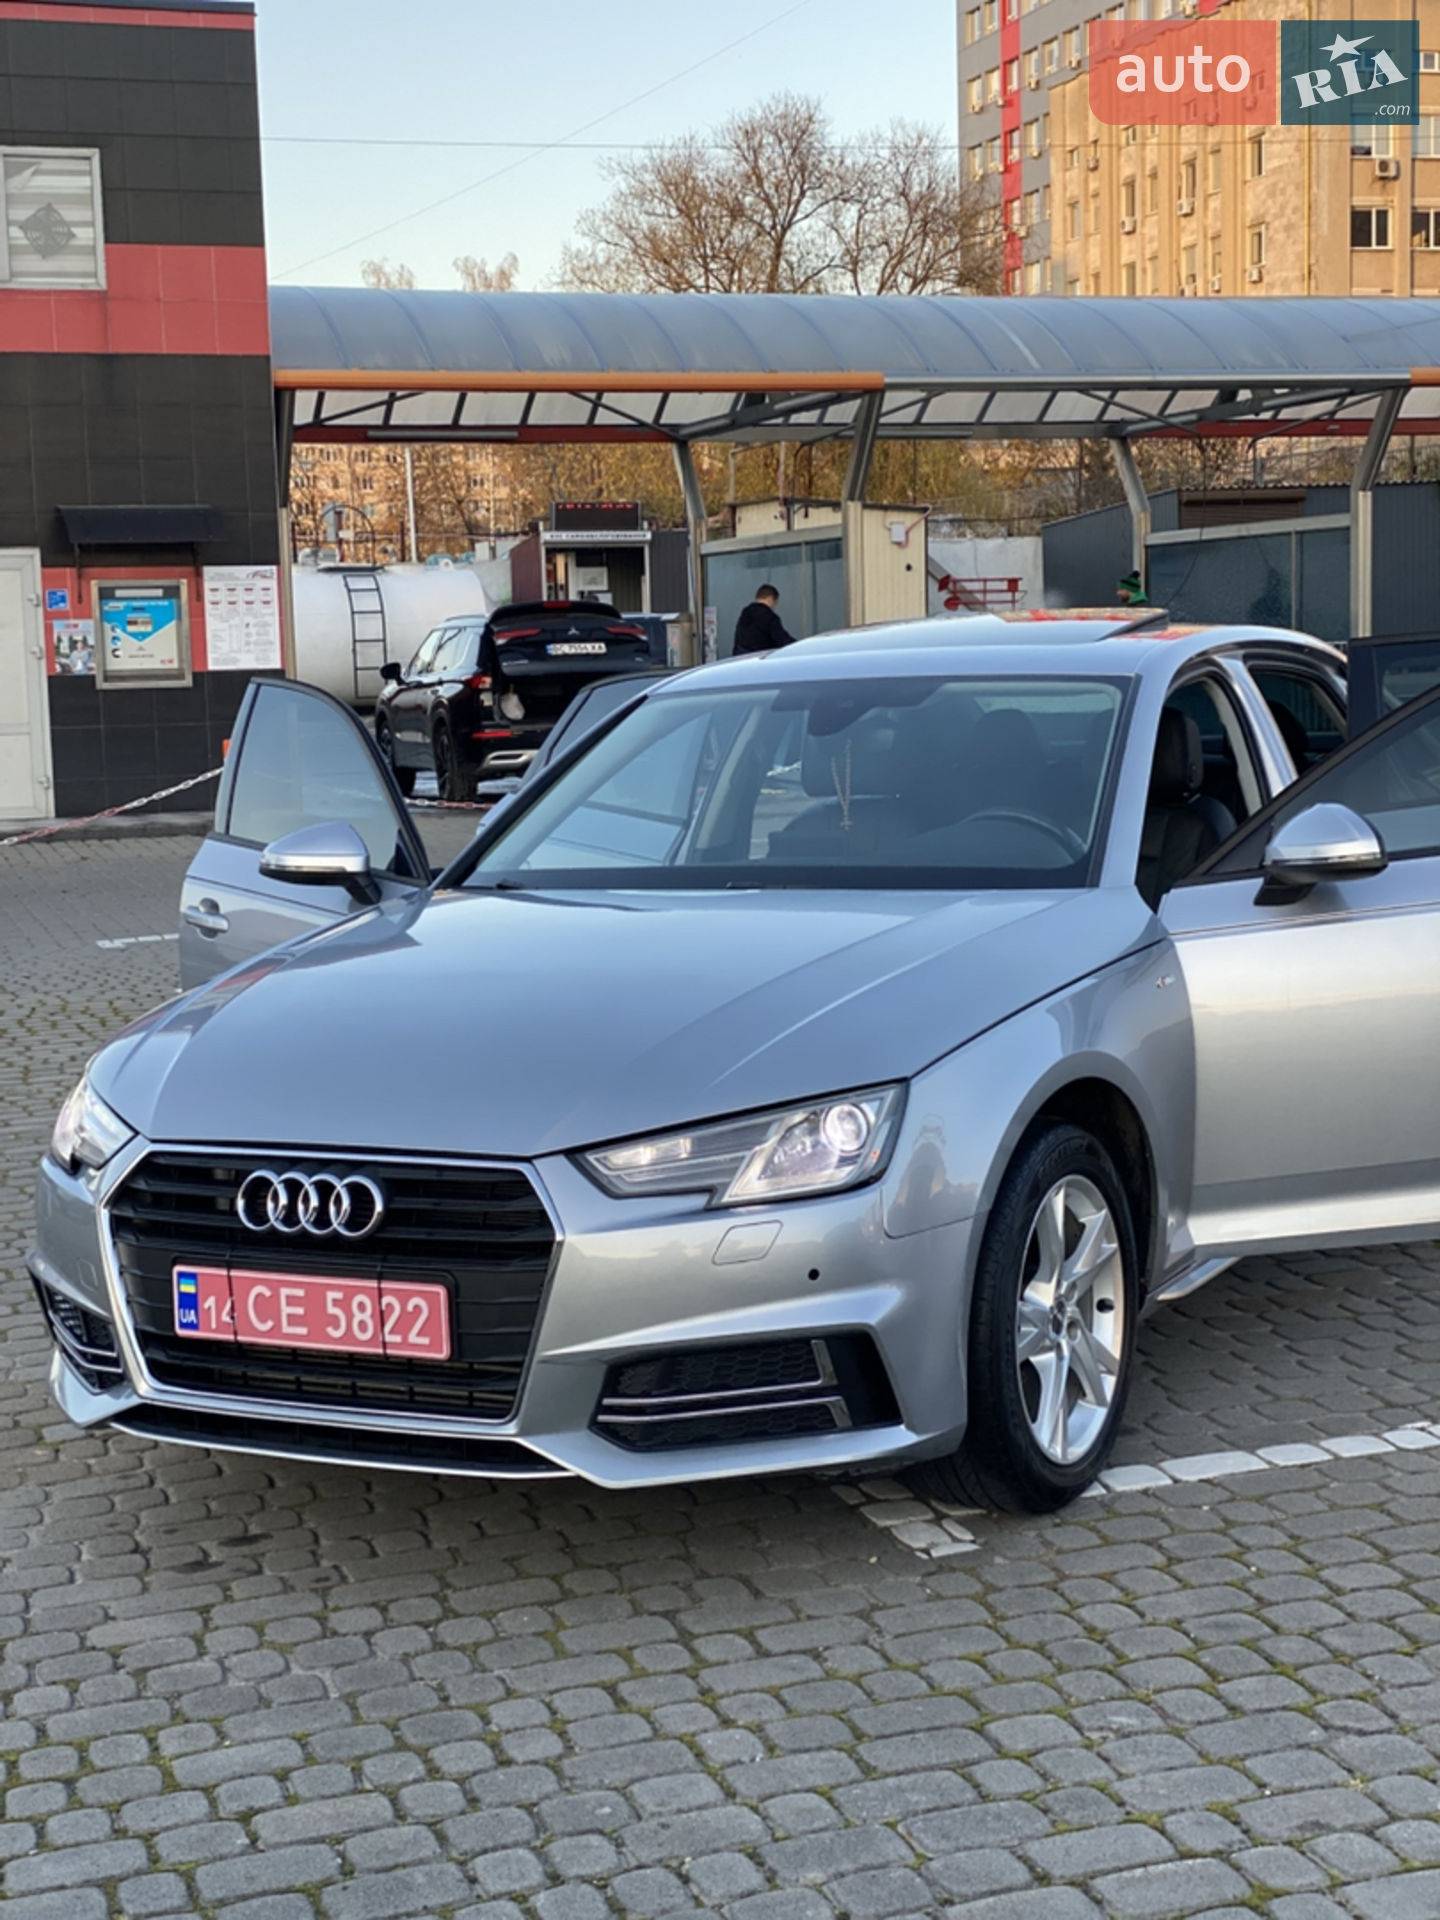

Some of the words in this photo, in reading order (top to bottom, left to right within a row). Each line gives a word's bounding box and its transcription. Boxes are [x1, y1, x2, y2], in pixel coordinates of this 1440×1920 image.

[179, 1308, 197, 1324] UA
[247, 1285, 309, 1336] CE
[325, 1290, 431, 1345] 5822
